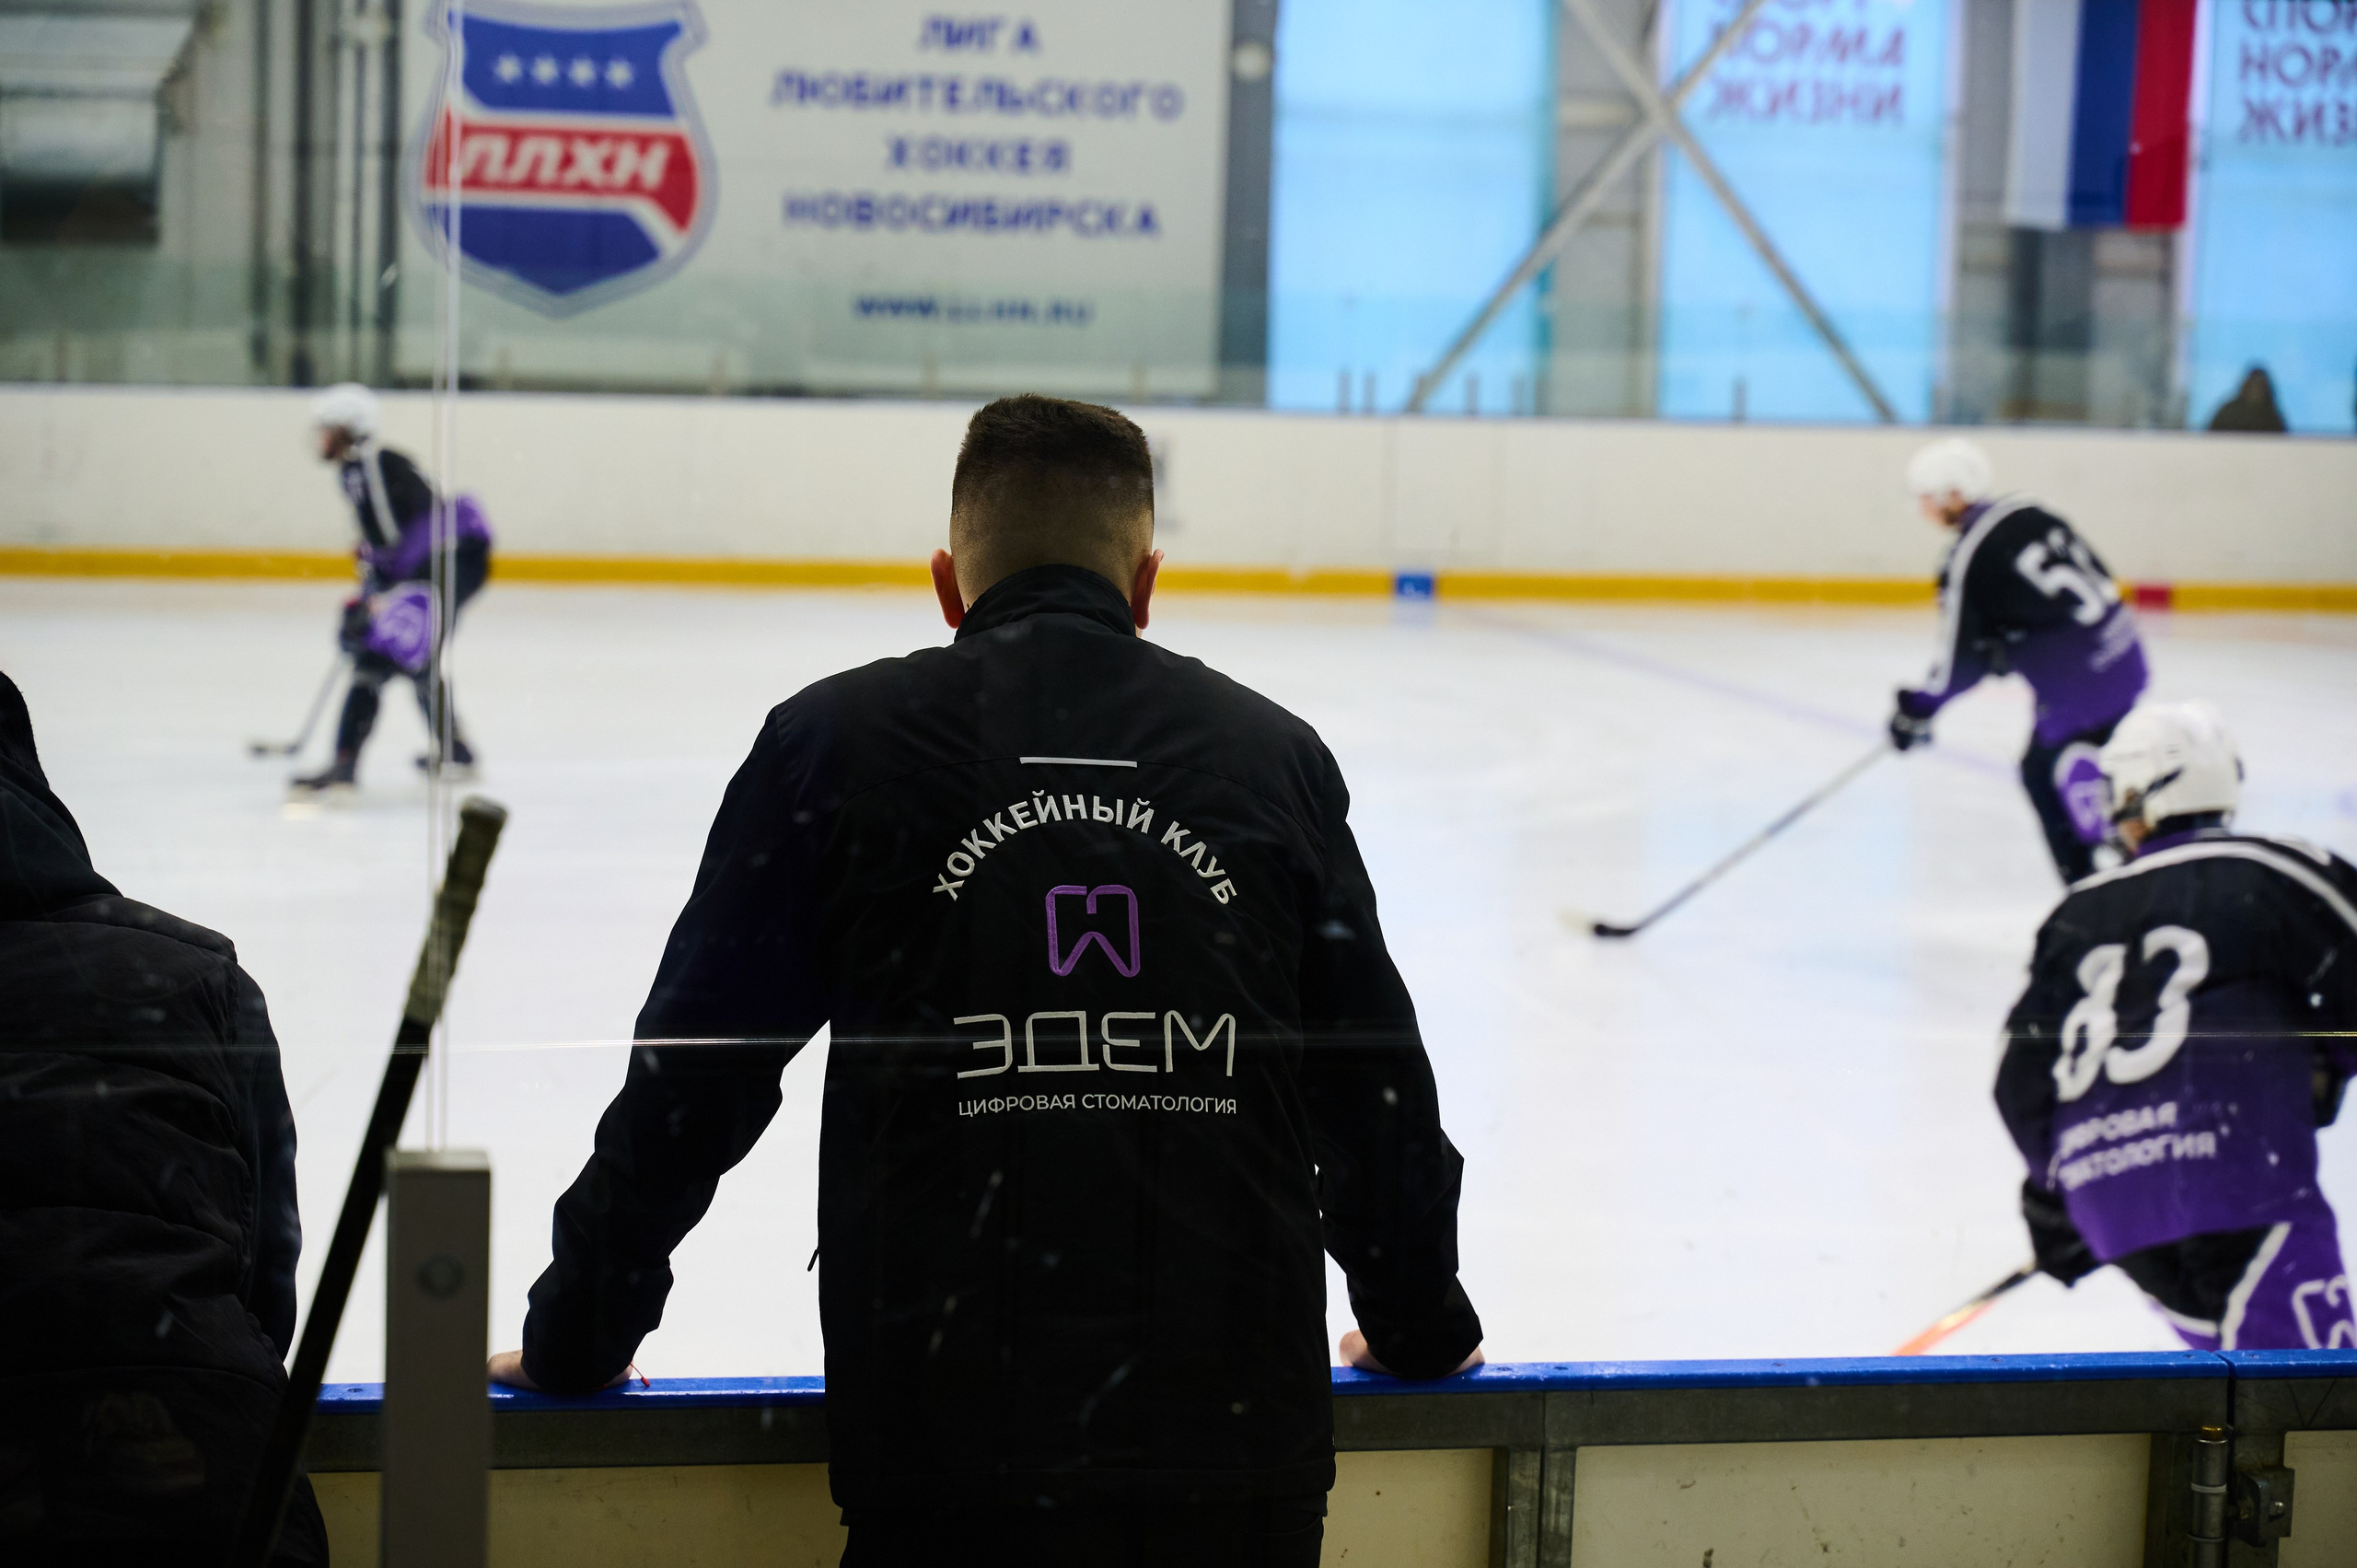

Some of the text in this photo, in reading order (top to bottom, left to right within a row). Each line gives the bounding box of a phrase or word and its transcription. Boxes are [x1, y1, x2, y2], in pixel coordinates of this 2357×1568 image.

[920, 16, 1041, 54] ЛИГА
[782, 192, 1161, 238] НОВОСИБИРСКА
[932, 789, 1237, 905] ХОККЕЙНЫЙ КЛУБ
[2052, 924, 2210, 1102] 83
[953, 1009, 1237, 1079] ЭДЕМ
[958, 1094, 1237, 1117] ЦИФРОВАЯ СТОМАТОЛОГИЯ
